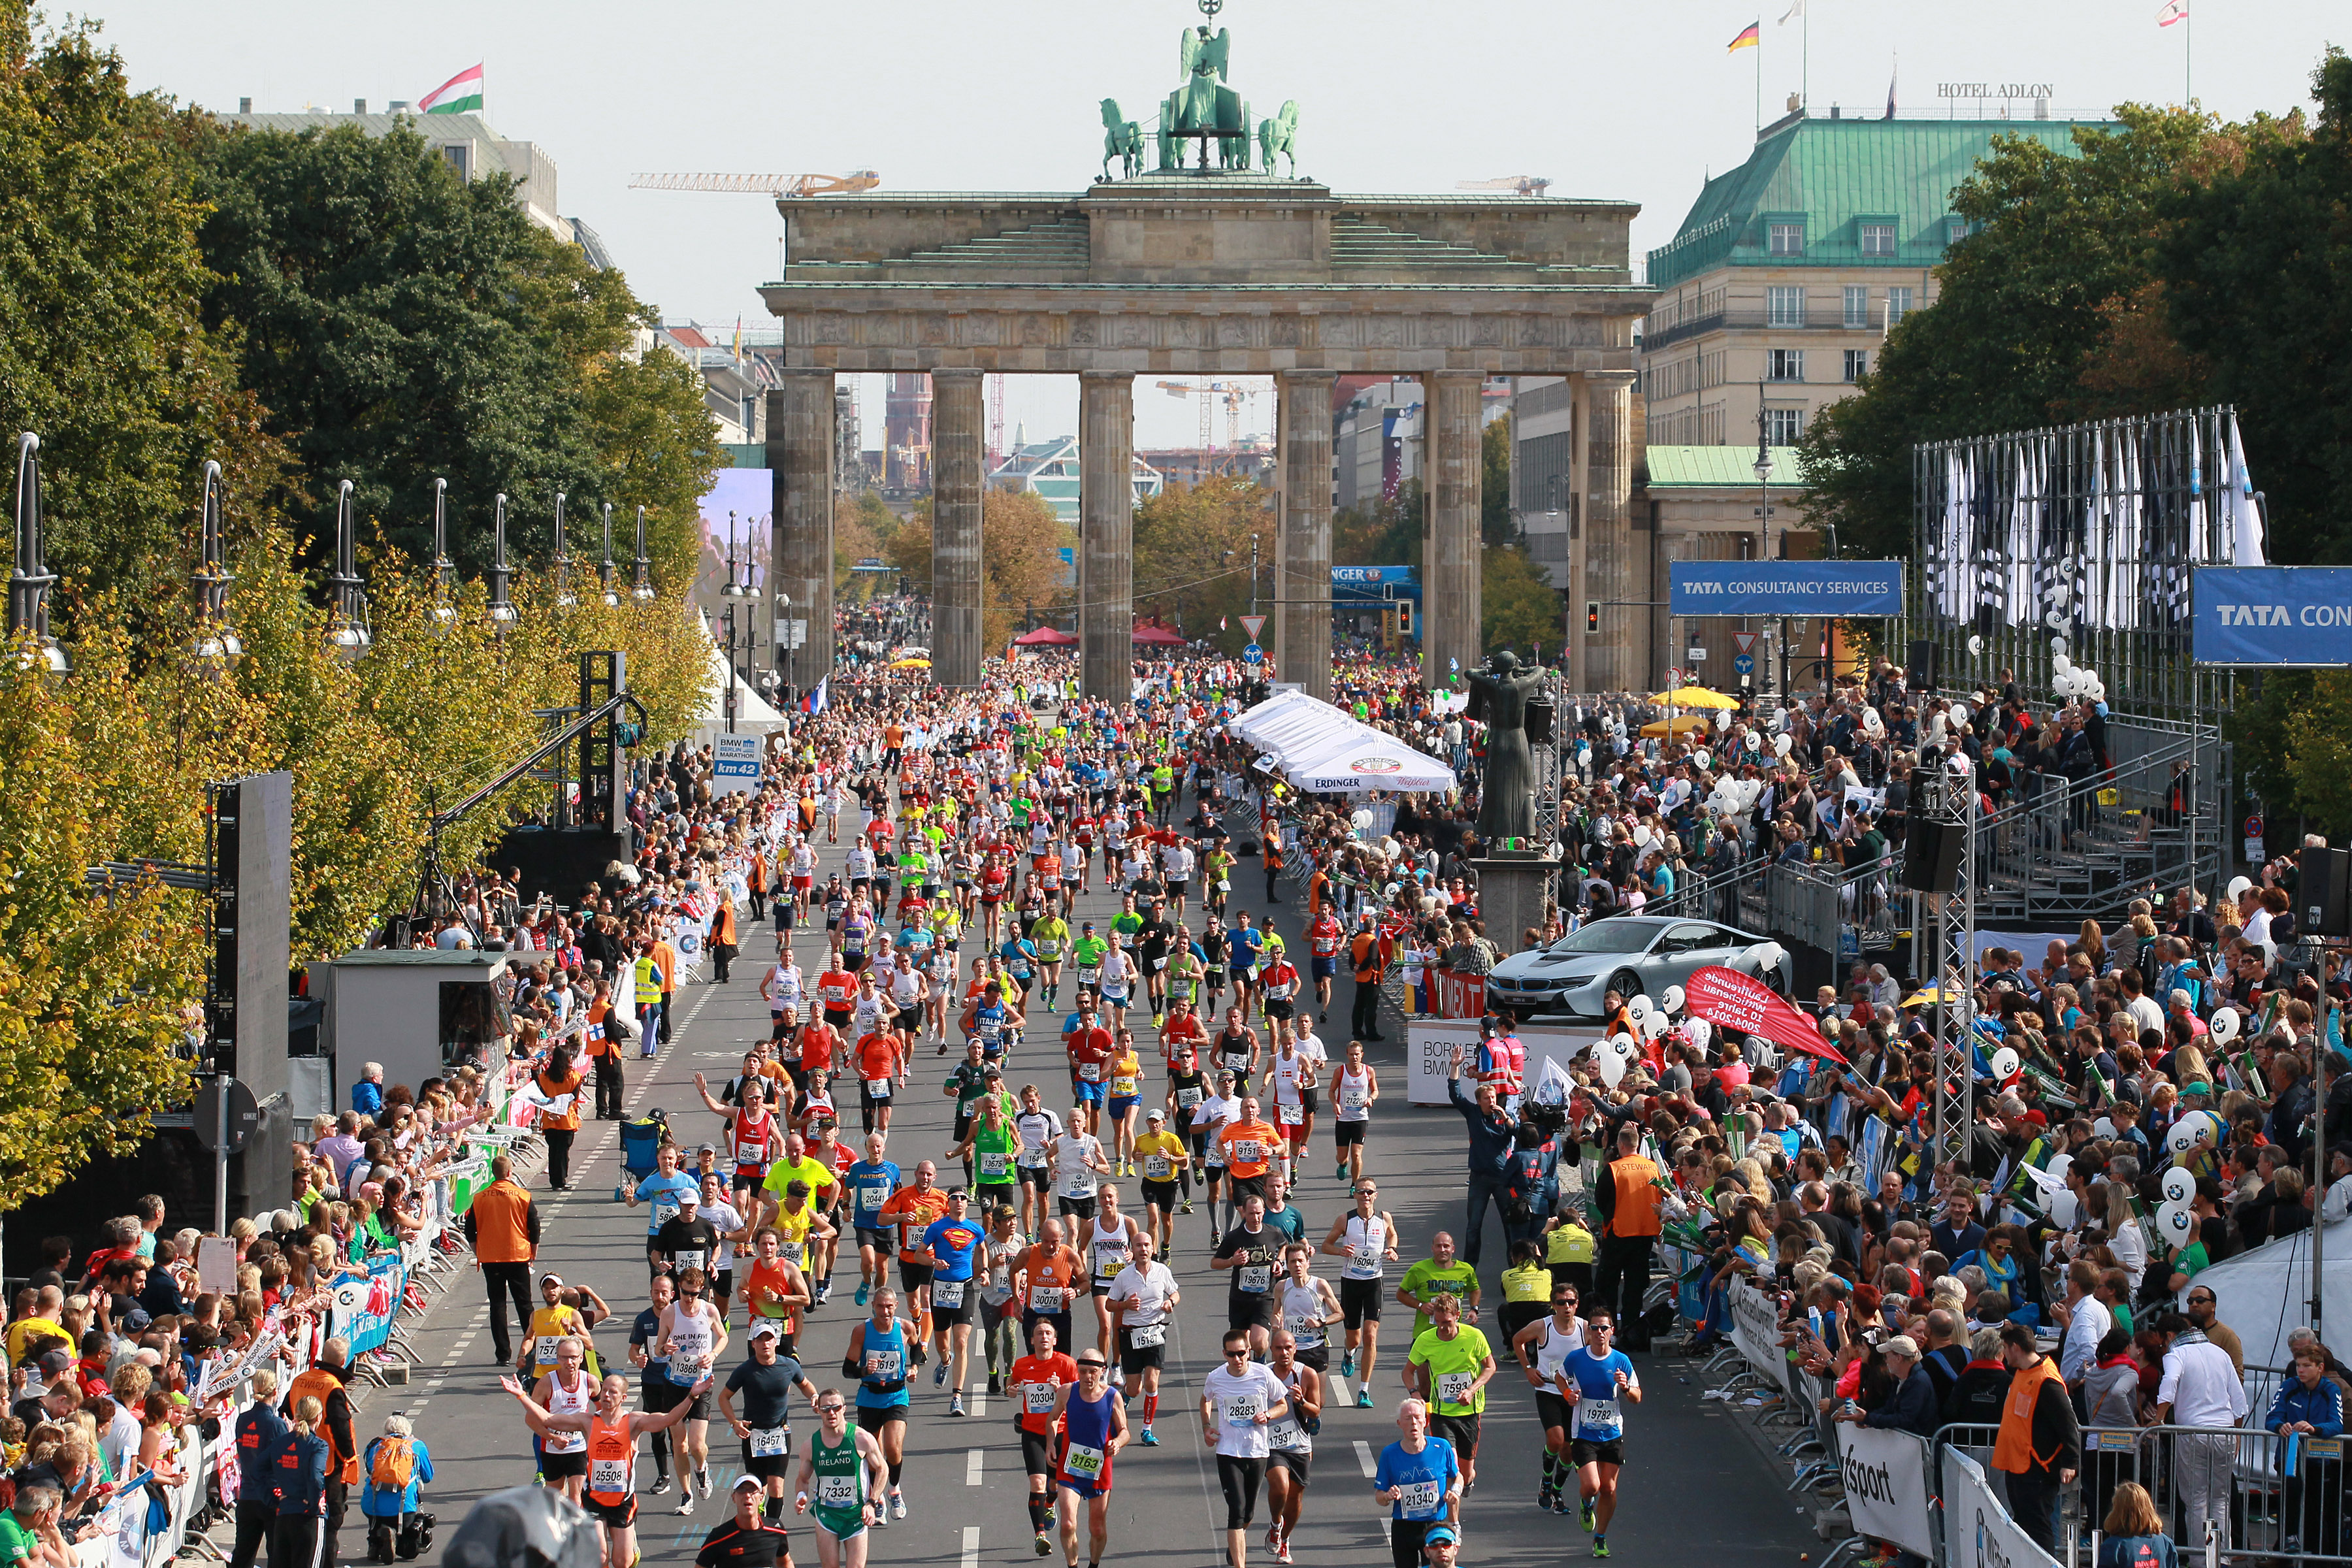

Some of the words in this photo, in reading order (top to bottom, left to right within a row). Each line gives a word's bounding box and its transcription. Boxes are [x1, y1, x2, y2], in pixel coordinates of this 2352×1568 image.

[1937, 83, 1992, 97] HOTEL
[1997, 83, 2053, 98] ADLON
[1682, 582, 1723, 594] TATA
[1728, 581, 1824, 594] CONSULTANCY
[1827, 581, 1889, 594] SERVICES
[2216, 605, 2292, 626] TATA
[717, 763, 737, 774] km
[738, 764, 756, 774] 42
[1315, 778, 1360, 789] ERDINGER
[1396, 777, 1430, 787] Weißbier
[1702, 1026, 1707, 1037] 3
[741, 1150, 759, 1159] 22463
[1238, 1147, 1257, 1156] 9151
[1148, 1161, 1166, 1169] 4132
[1621, 1163, 1657, 1171] STEWARD
[1070, 1180, 1088, 1188] 12244
[866, 1194, 885, 1203] 20441
[779, 1249, 799, 1258] 25469
[680, 1259, 700, 1267] 21573
[1354, 1256, 1375, 1266] 16094
[1245, 1275, 1266, 1284] 19676
[938, 1290, 960, 1299] 18777
[1035, 1295, 1058, 1305] 30076
[1136, 1334, 1157, 1346] 15187
[538, 1345, 557, 1354] 757
[676, 1363, 698, 1373] 13868
[295, 1378, 325, 1391] STEWARD
[1030, 1393, 1054, 1403] 20304
[1230, 1405, 1255, 1416] 28283
[1587, 1409, 1611, 1420] 19782
[757, 1435, 780, 1446] 16467
[1269, 1431, 1293, 1446] 17937
[819, 1457, 851, 1466] IRELAND
[1071, 1454, 1099, 1469] 3163
[595, 1471, 622, 1481] 25508
[825, 1487, 851, 1497] 7332
[1406, 1492, 1433, 1505] 21340
